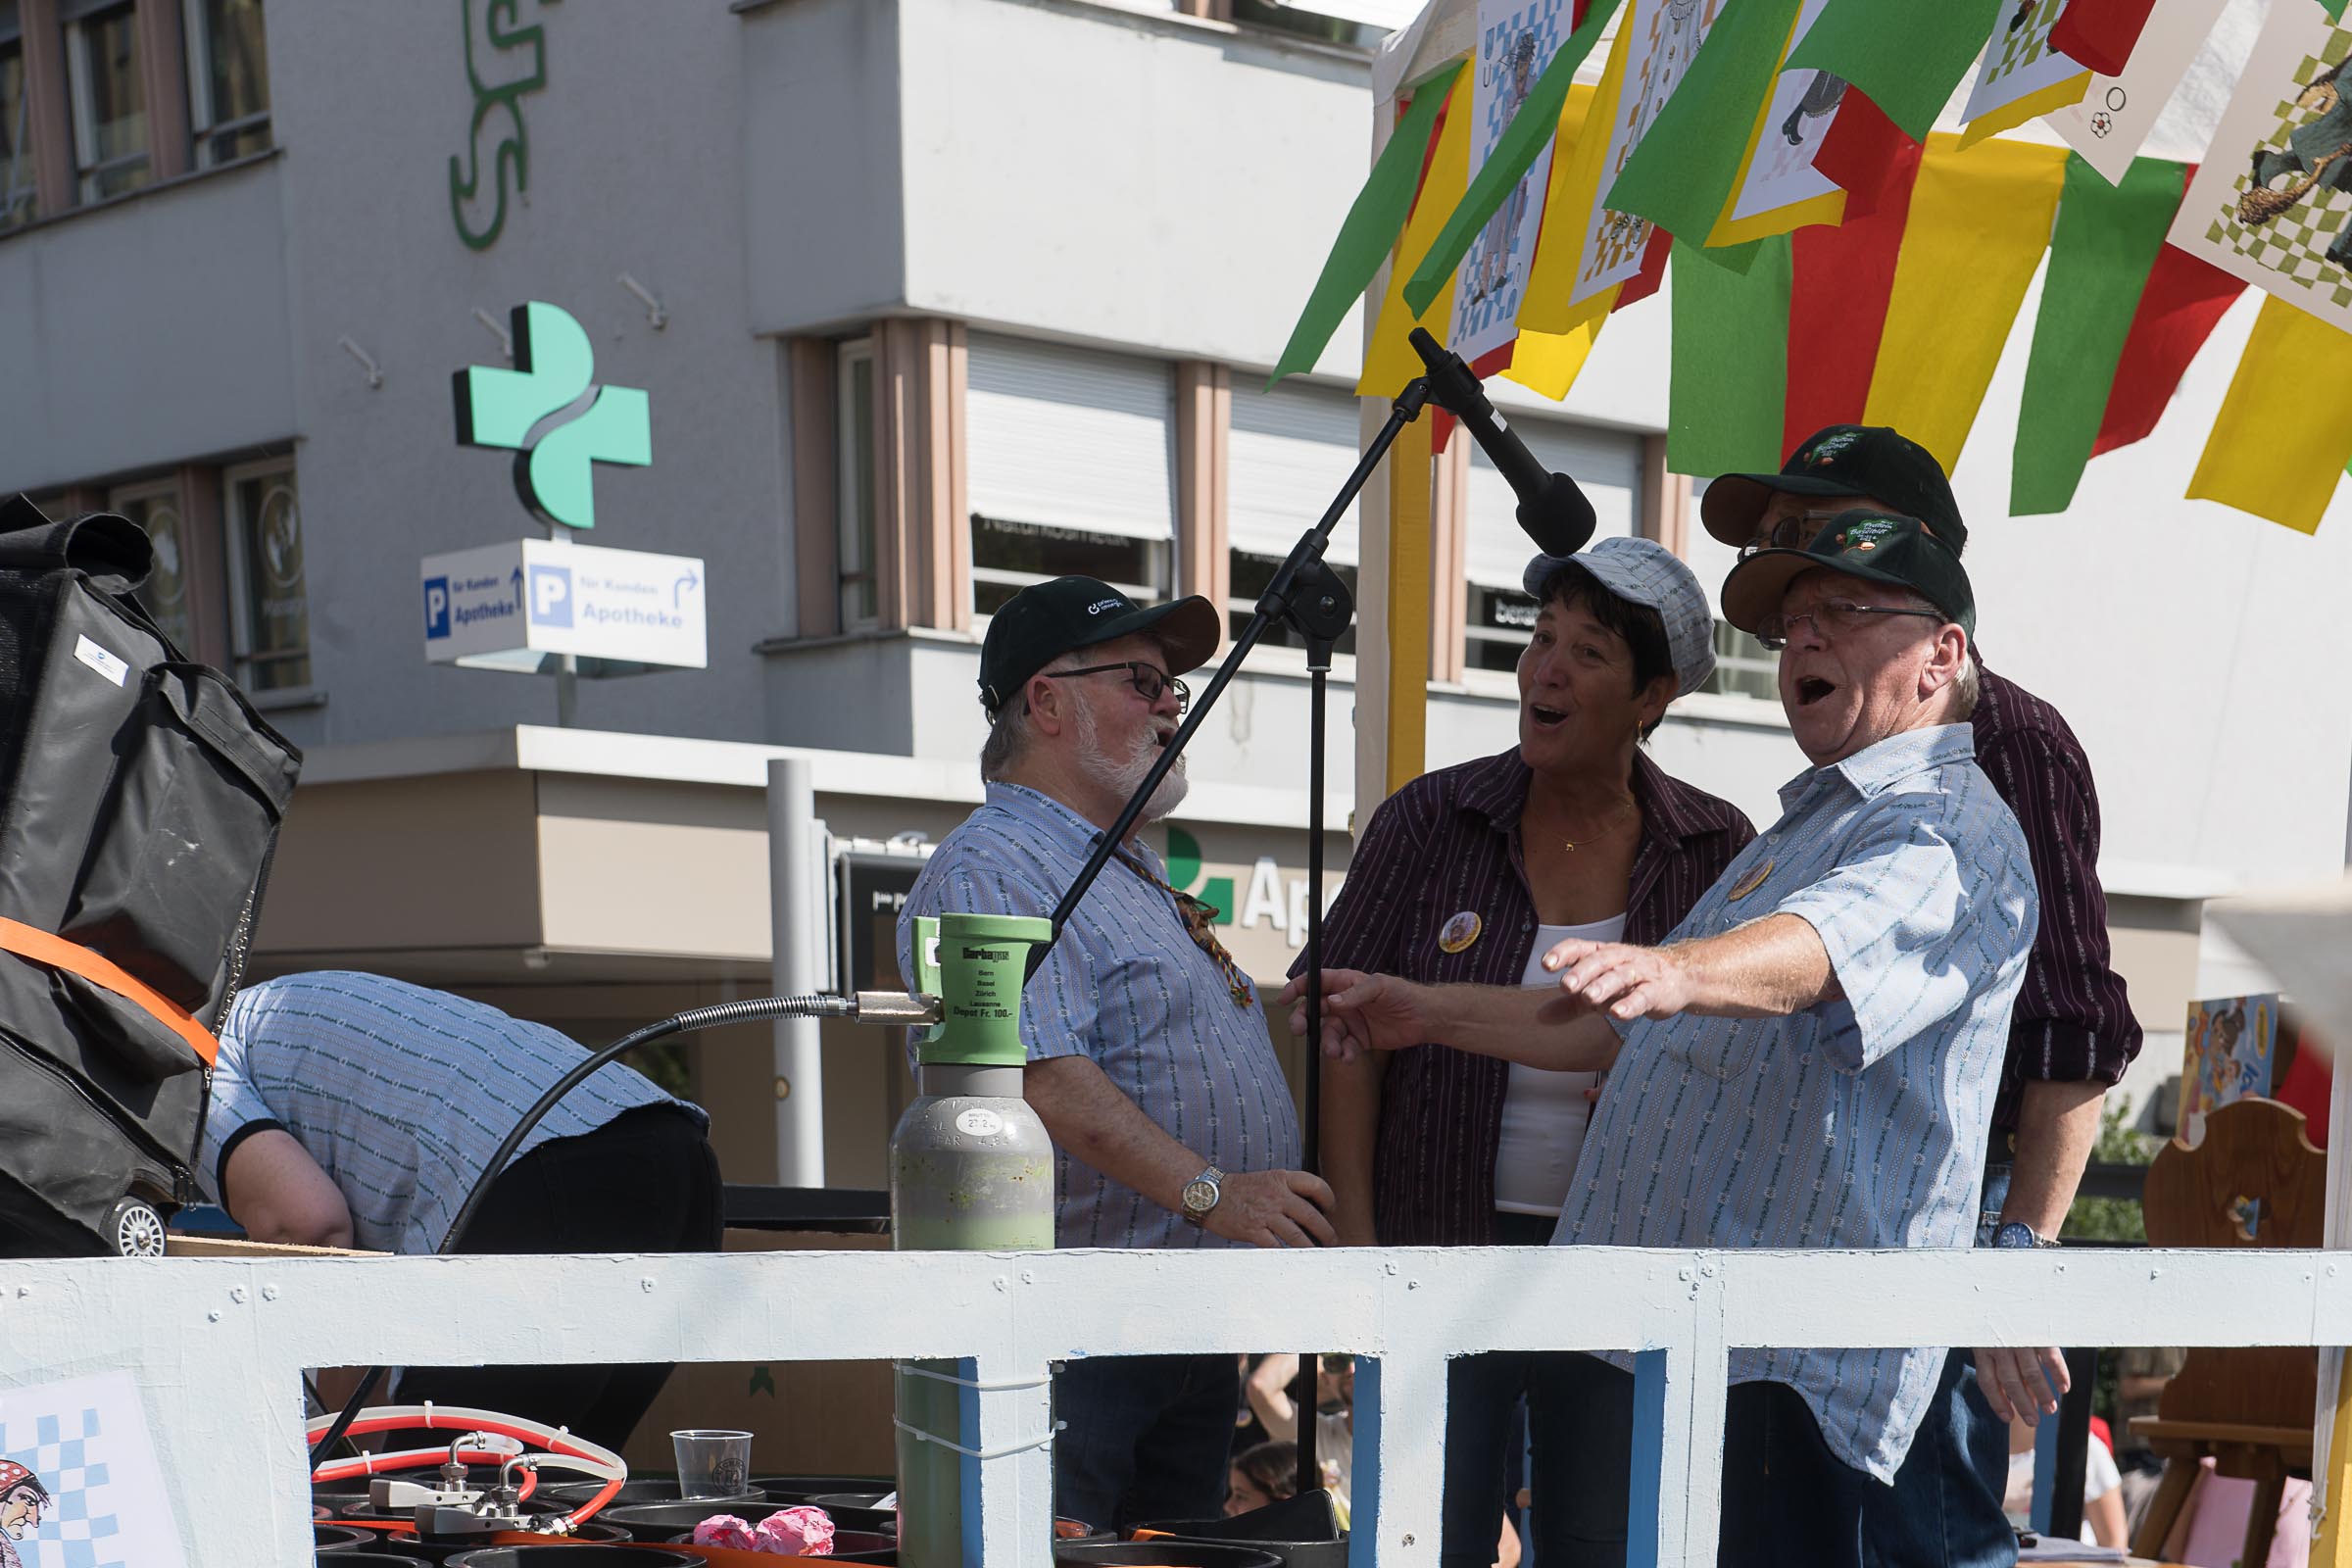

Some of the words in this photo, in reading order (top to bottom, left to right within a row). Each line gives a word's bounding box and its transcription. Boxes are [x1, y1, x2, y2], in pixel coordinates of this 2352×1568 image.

[2106, 86, 2127, 112] O
[467, 576, 500, 591] Kunden
[534, 573, 566, 615] P
[579, 574, 599, 589] für
[605, 576, 659, 597] Kunden
[455, 600, 514, 626] Apotheke
[582, 602, 683, 630] Apotheke
[1241, 856, 1346, 948] Ap
[953, 1005, 978, 1018] Depot
[980, 1008, 991, 1018] Fr.
[994, 1008, 1013, 1018] 100.-
